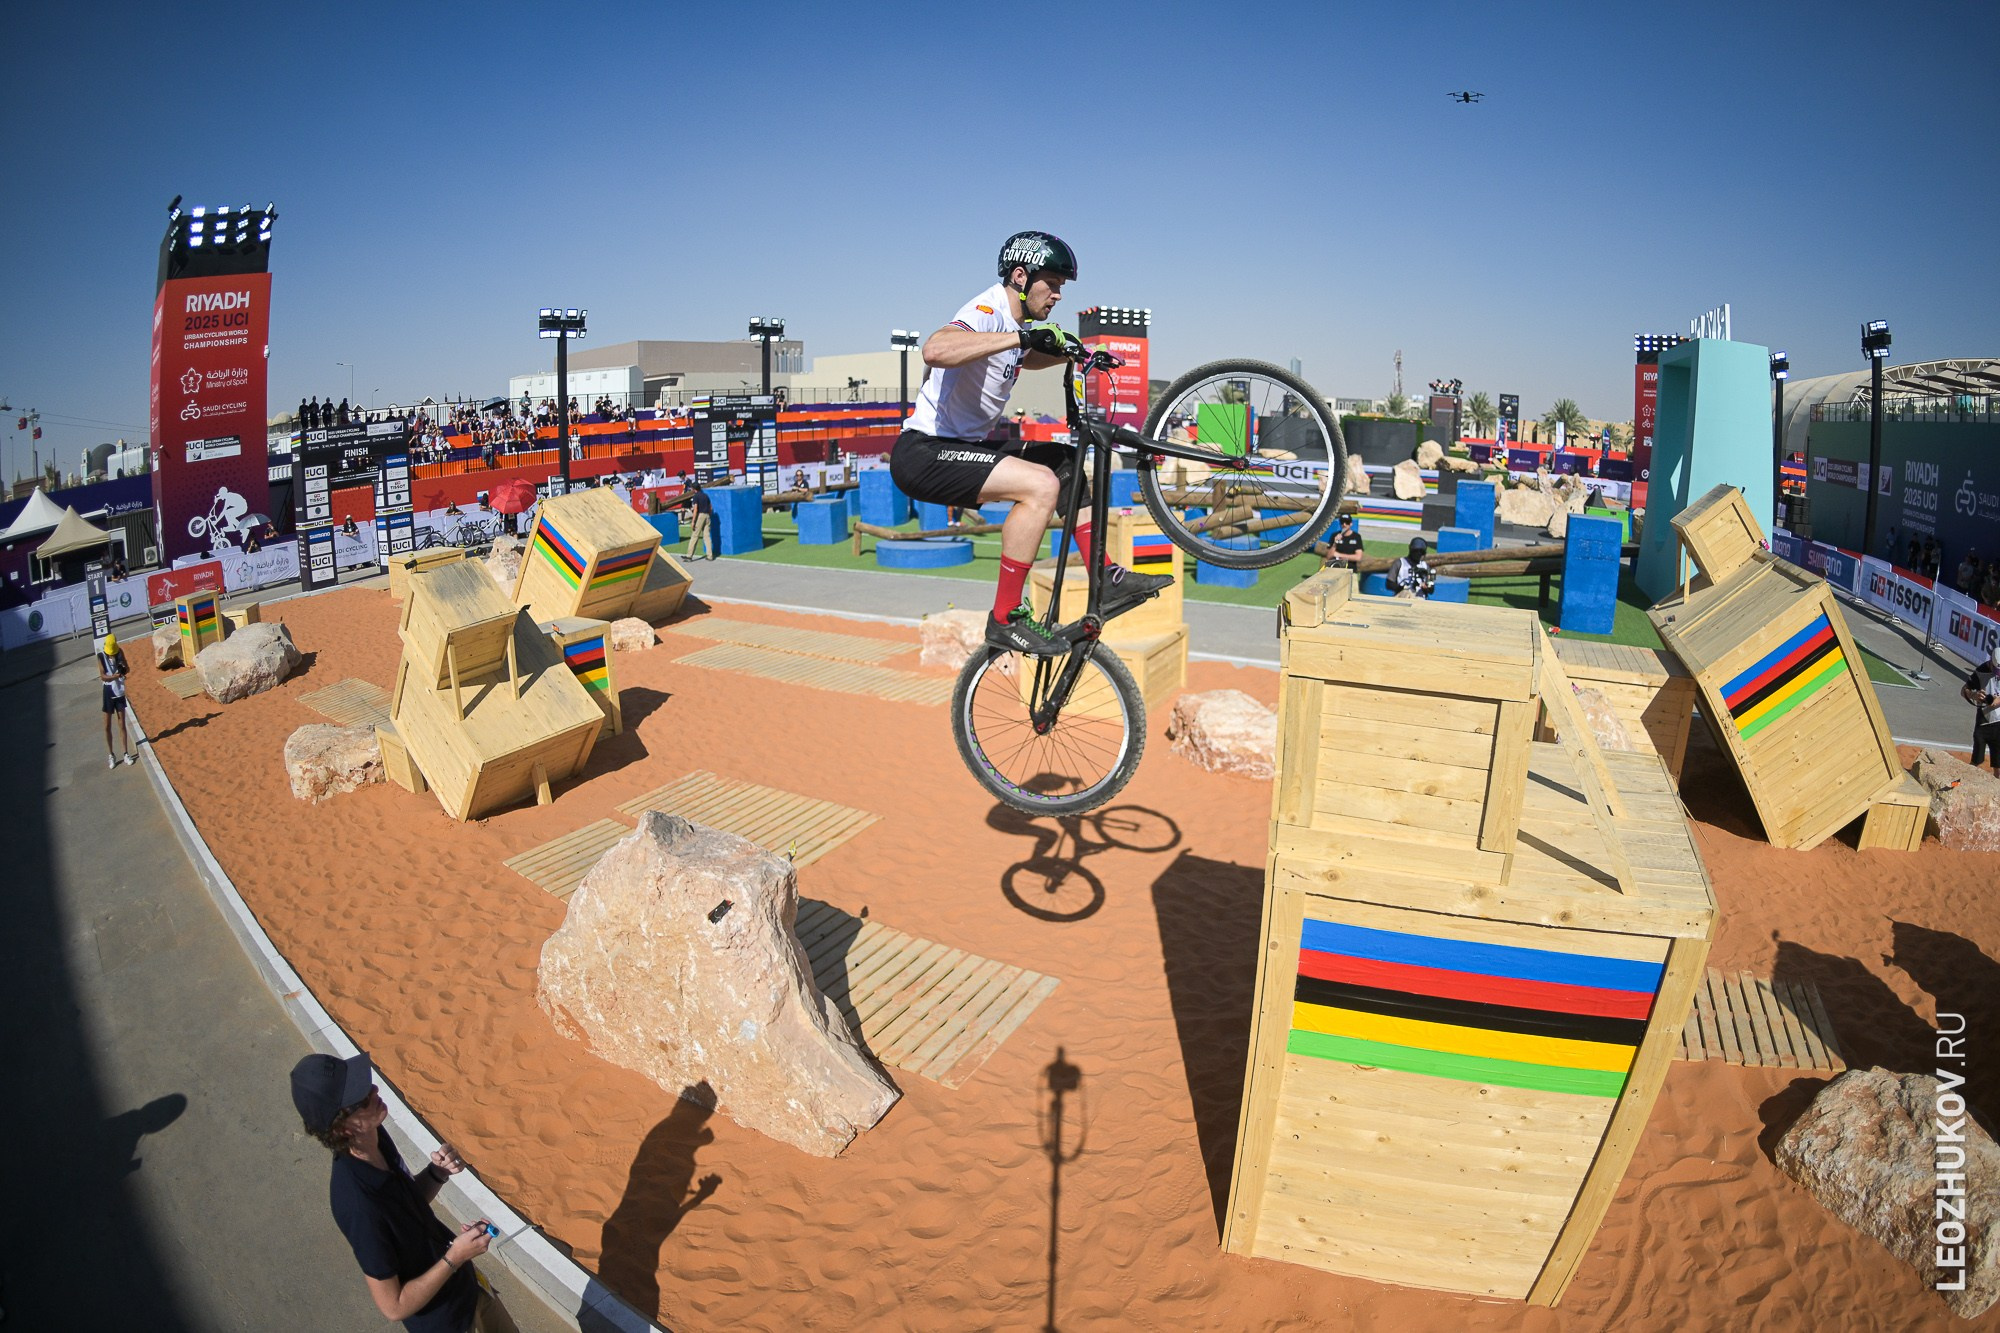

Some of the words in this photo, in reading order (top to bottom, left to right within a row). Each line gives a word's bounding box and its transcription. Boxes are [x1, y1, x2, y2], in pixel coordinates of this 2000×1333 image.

[1003, 249, 1046, 266] CONTROL
[186, 291, 250, 312] RIYADH
[185, 315, 220, 330] 2025
[223, 312, 249, 328] UCI
[184, 337, 248, 350] CHAMPIONSHIPS
[1109, 342, 1141, 352] RIYADH
[206, 369, 230, 381] الرياضة
[233, 368, 248, 379] وزارة
[1643, 372, 1658, 381] RIYA
[206, 380, 226, 388] Ministry
[222, 402, 247, 410] CYCLING
[309, 431, 325, 441] UCI
[189, 442, 203, 450] UCI
[344, 447, 369, 457] FINISH
[309, 467, 325, 476] UCI
[1274, 466, 1309, 480] UCI
[1814, 461, 1828, 477] UCI
[1905, 461, 1939, 487] RIYADH
[309, 496, 326, 504] TISSOT
[1903, 487, 1922, 507] 2025
[1923, 491, 1938, 511] UCI
[1978, 492, 1999, 509] SAUDI
[346, 544, 368, 552] CYCLING
[396, 541, 411, 551] UCI
[315, 555, 331, 565] UCI
[87, 571, 103, 581] START
[194, 571, 214, 580] RIYADH
[94, 580, 100, 595] 1
[1886, 580, 1931, 619] TISSOT
[1972, 619, 2000, 657] TIS
